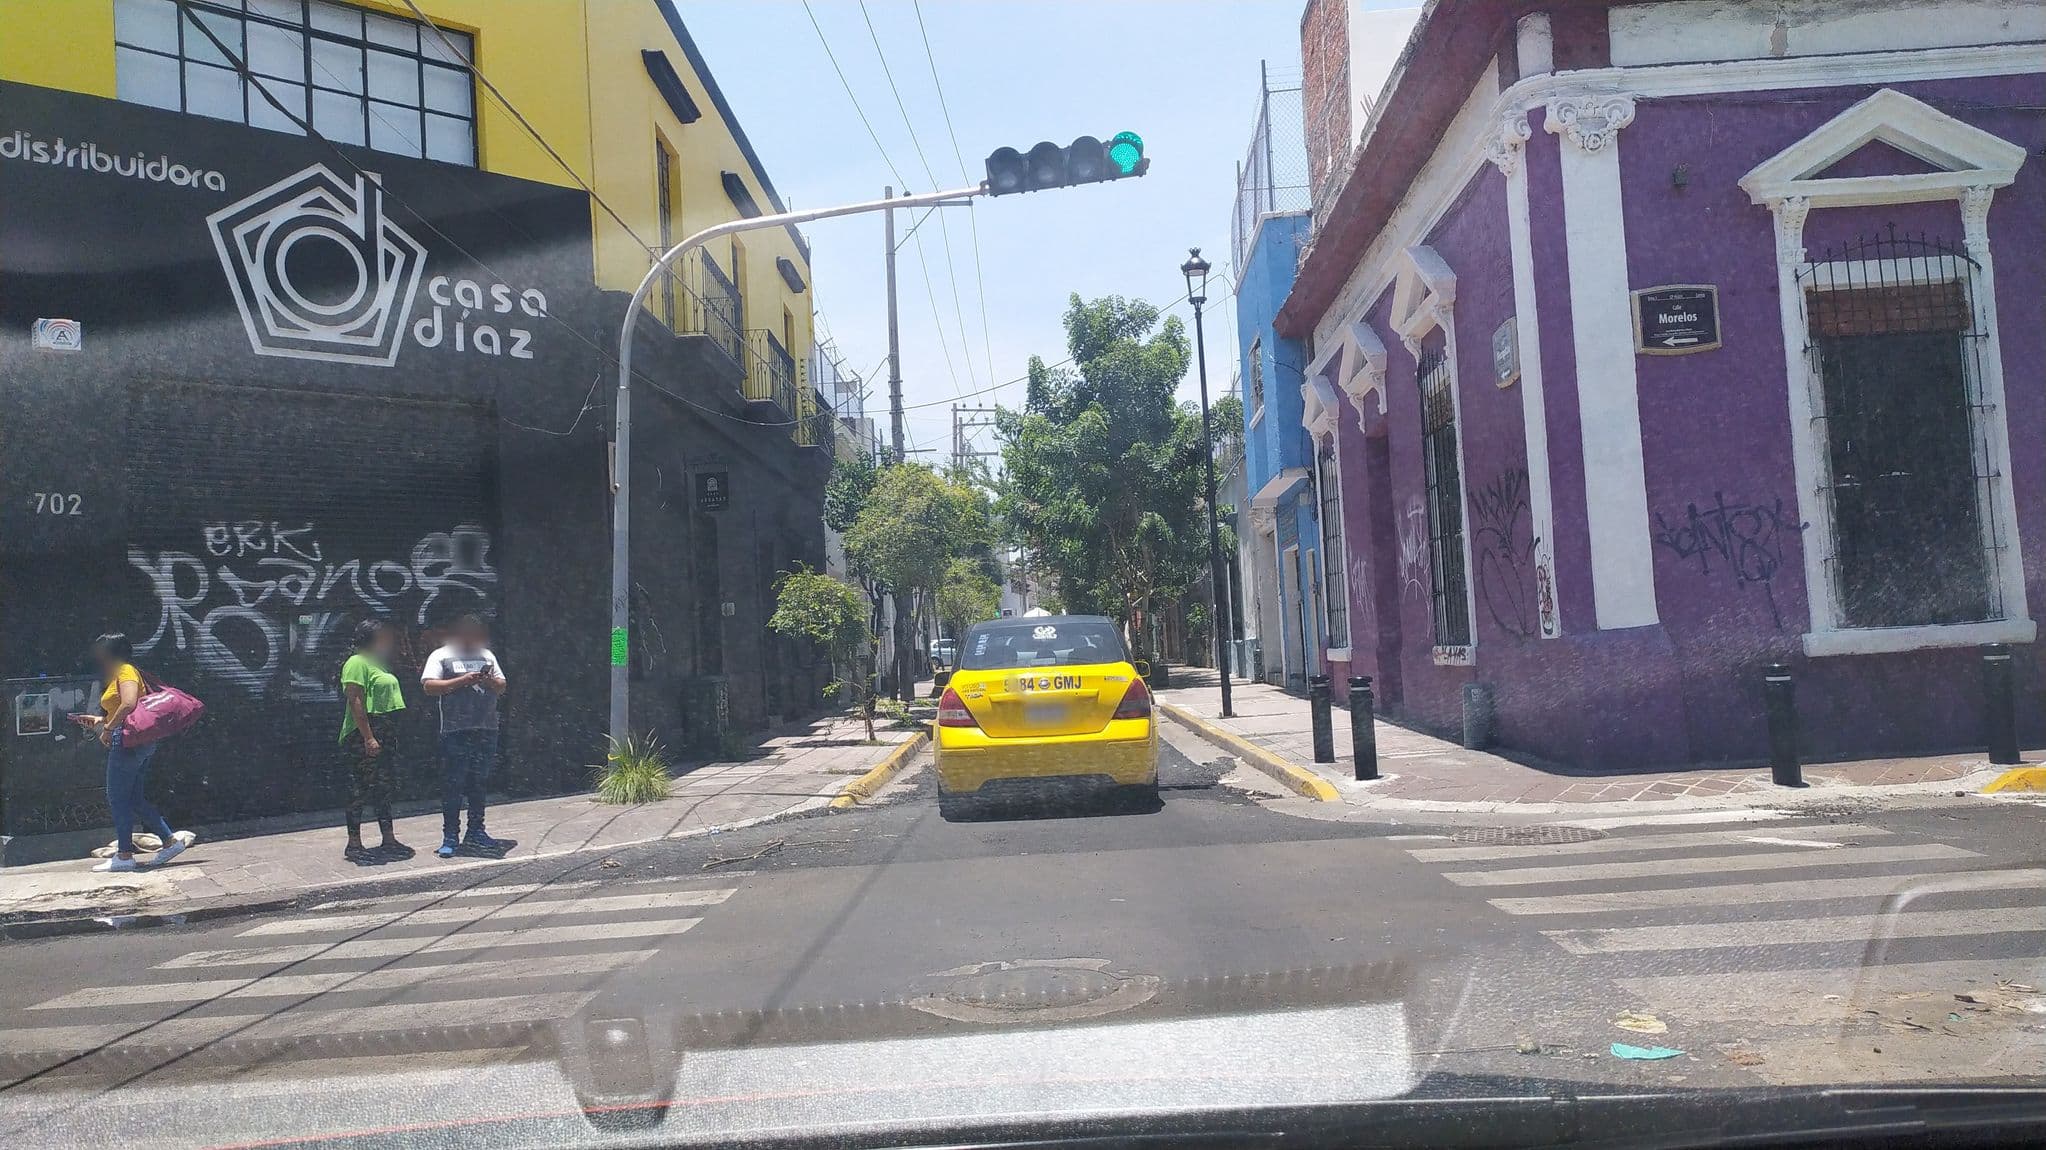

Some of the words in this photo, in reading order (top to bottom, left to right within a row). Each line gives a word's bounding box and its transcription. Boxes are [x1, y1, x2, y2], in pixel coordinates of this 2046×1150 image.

[0, 131, 227, 192] distribuidora
[428, 275, 548, 318] casa
[413, 307, 535, 360] díaz
[1658, 311, 1698, 324] Morelos
[34, 492, 82, 515] 702
[1053, 675, 1082, 689] GMJ
